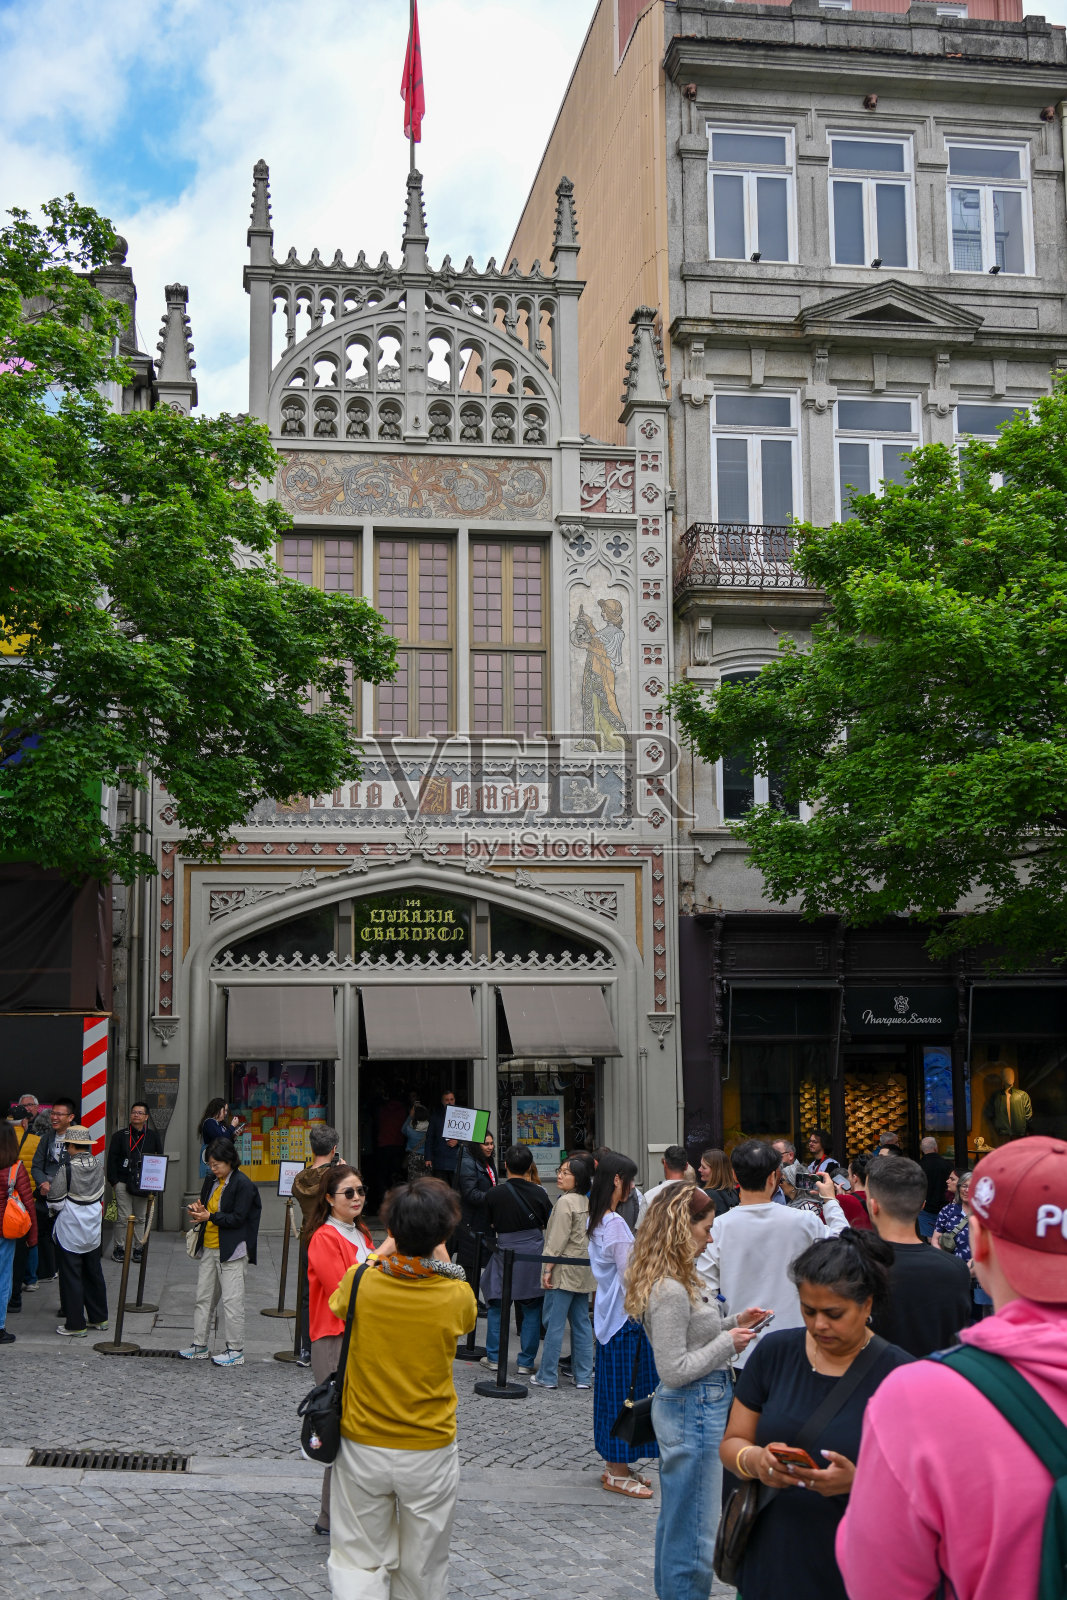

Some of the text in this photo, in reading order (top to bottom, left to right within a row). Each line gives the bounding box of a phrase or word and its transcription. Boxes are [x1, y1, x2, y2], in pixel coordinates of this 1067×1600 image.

[405, 899, 421, 907] 144
[862, 1009, 942, 1026] Marques Soares
